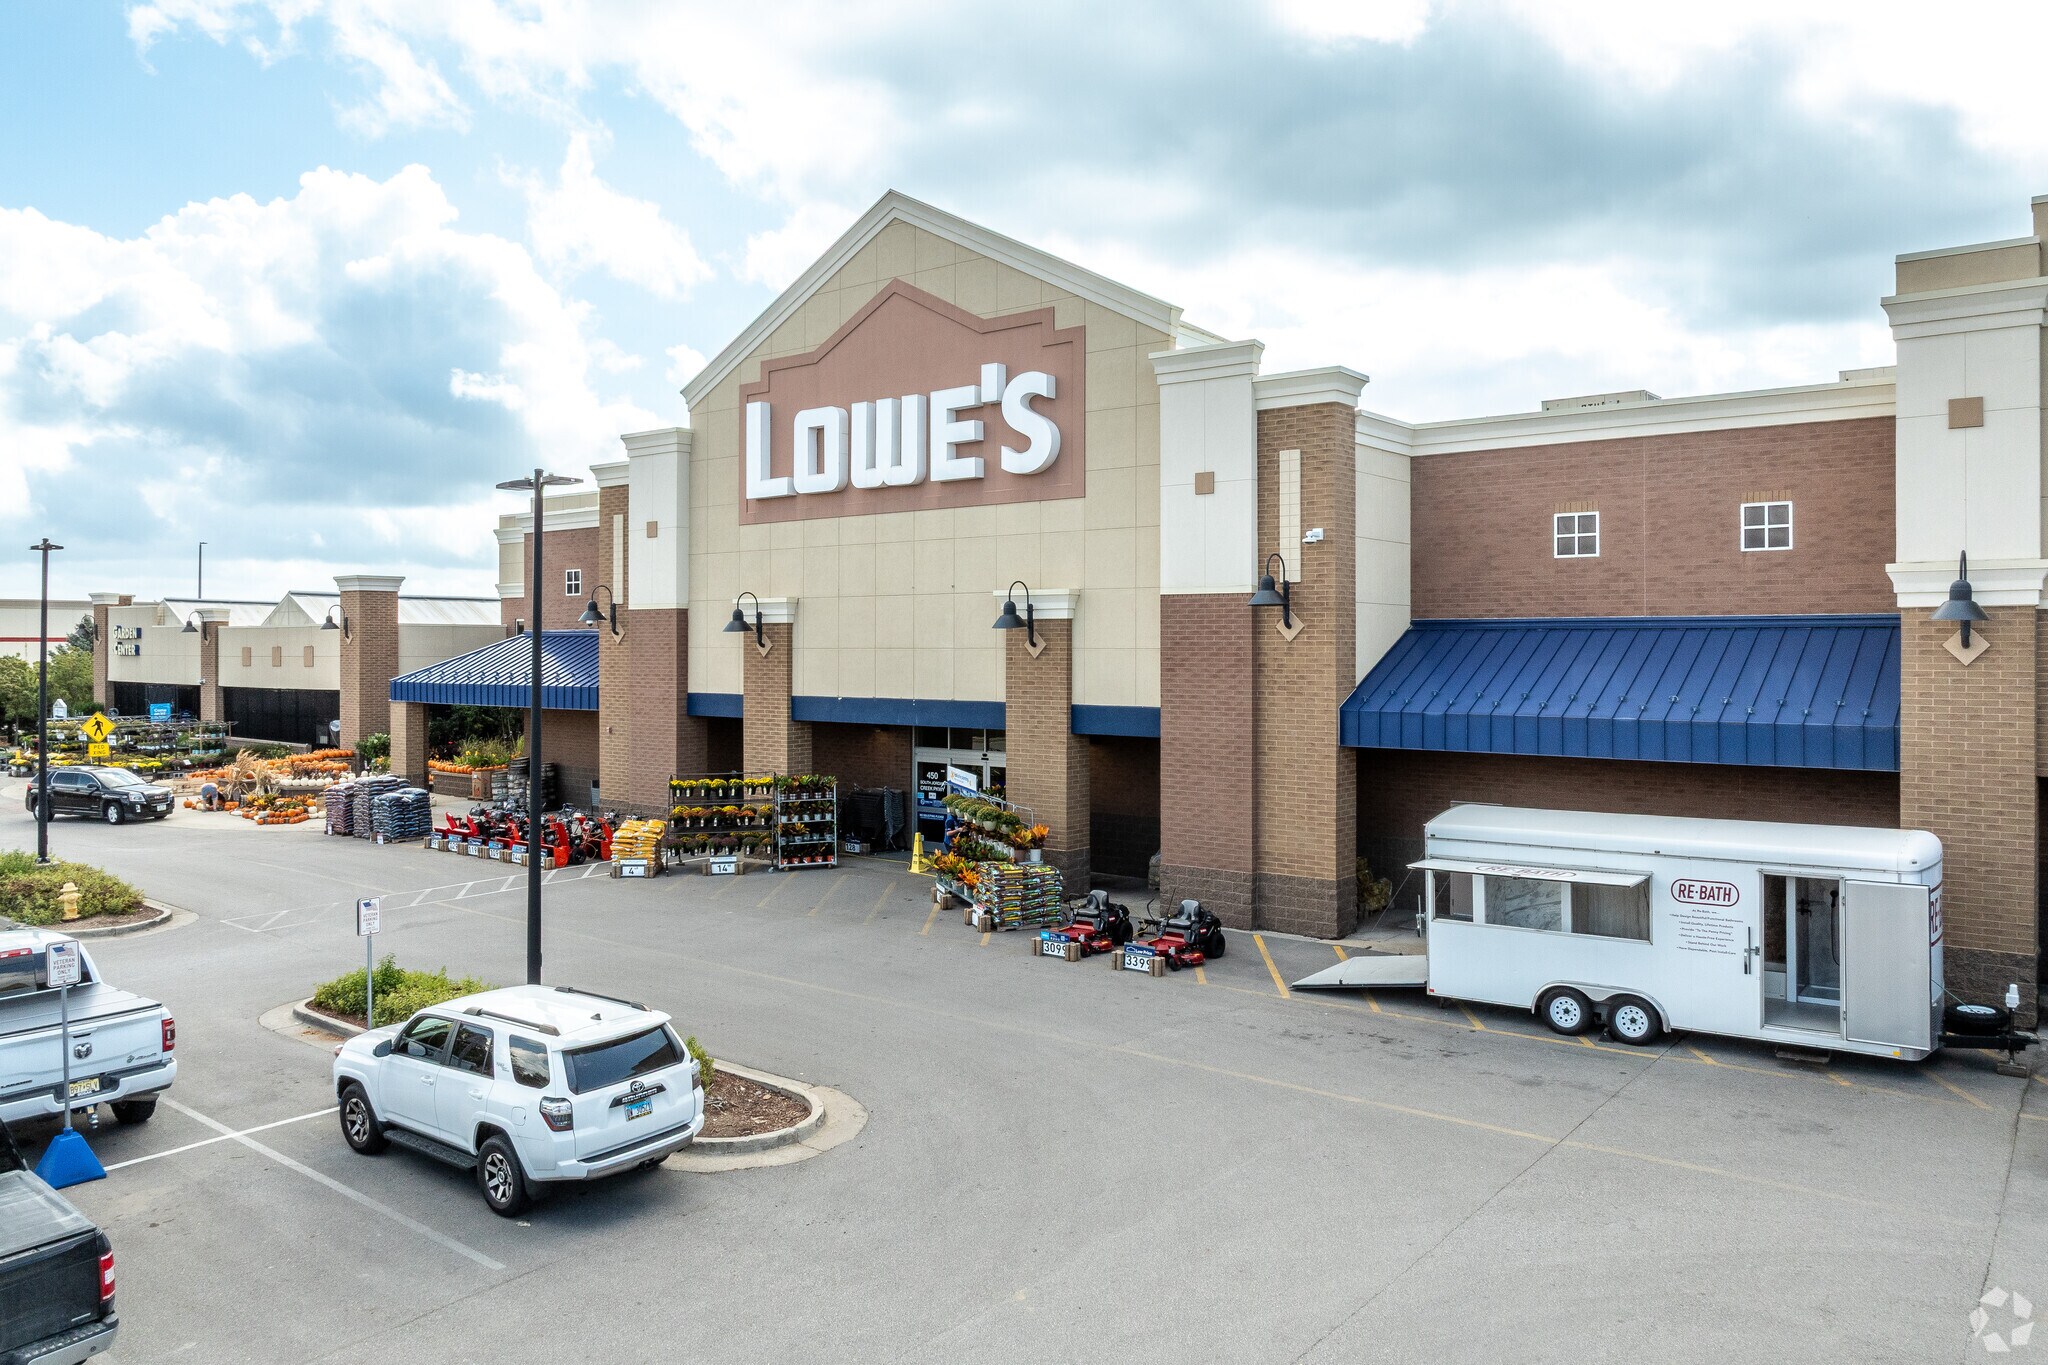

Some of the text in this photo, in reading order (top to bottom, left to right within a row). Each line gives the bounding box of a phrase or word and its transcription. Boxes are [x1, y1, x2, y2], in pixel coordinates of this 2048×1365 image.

[746, 363, 1061, 500] LOWE'S
[113, 624, 142, 639] GARDEN
[113, 641, 140, 656] CENTER
[926, 771, 938, 780] 450
[53, 957, 75, 965] VETERAN
[53, 962, 75, 970] PARKING
